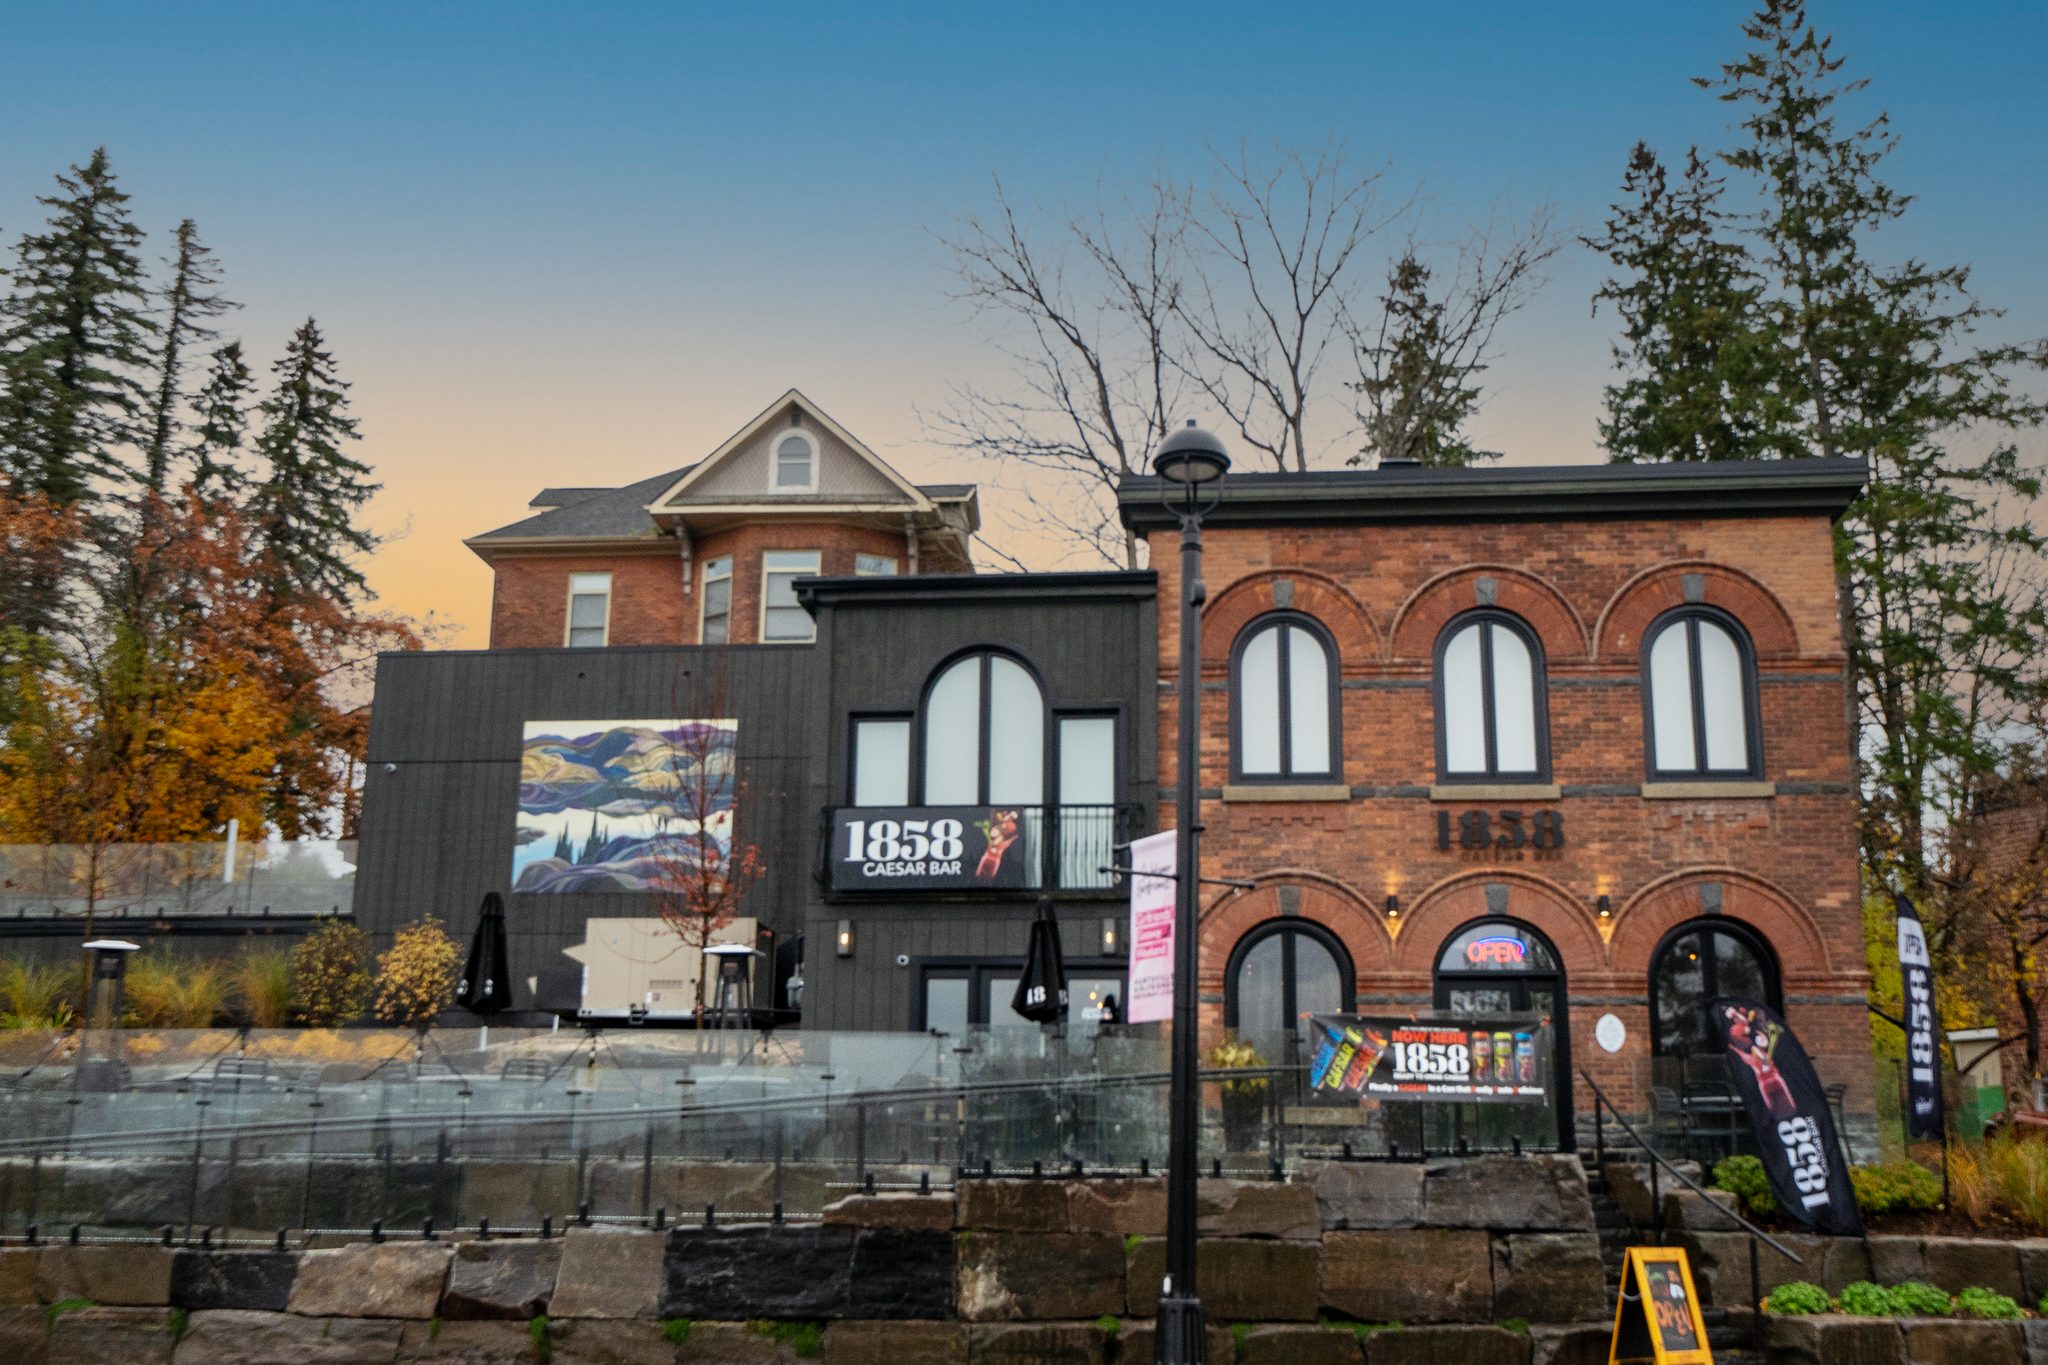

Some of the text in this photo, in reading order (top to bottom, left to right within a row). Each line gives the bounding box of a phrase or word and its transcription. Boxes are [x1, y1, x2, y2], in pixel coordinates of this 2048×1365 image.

[844, 818, 964, 862] 1858
[1435, 810, 1565, 849] 1858
[863, 861, 962, 877] CAESAR BAR
[1467, 942, 1522, 963] OPEN
[1392, 1030, 1468, 1044] NOW HERE
[1909, 969, 1934, 1086] 1858
[1392, 1042, 1470, 1074] 1858
[1806, 1116, 1820, 1137] BAR
[1778, 1116, 1831, 1212] 1858
